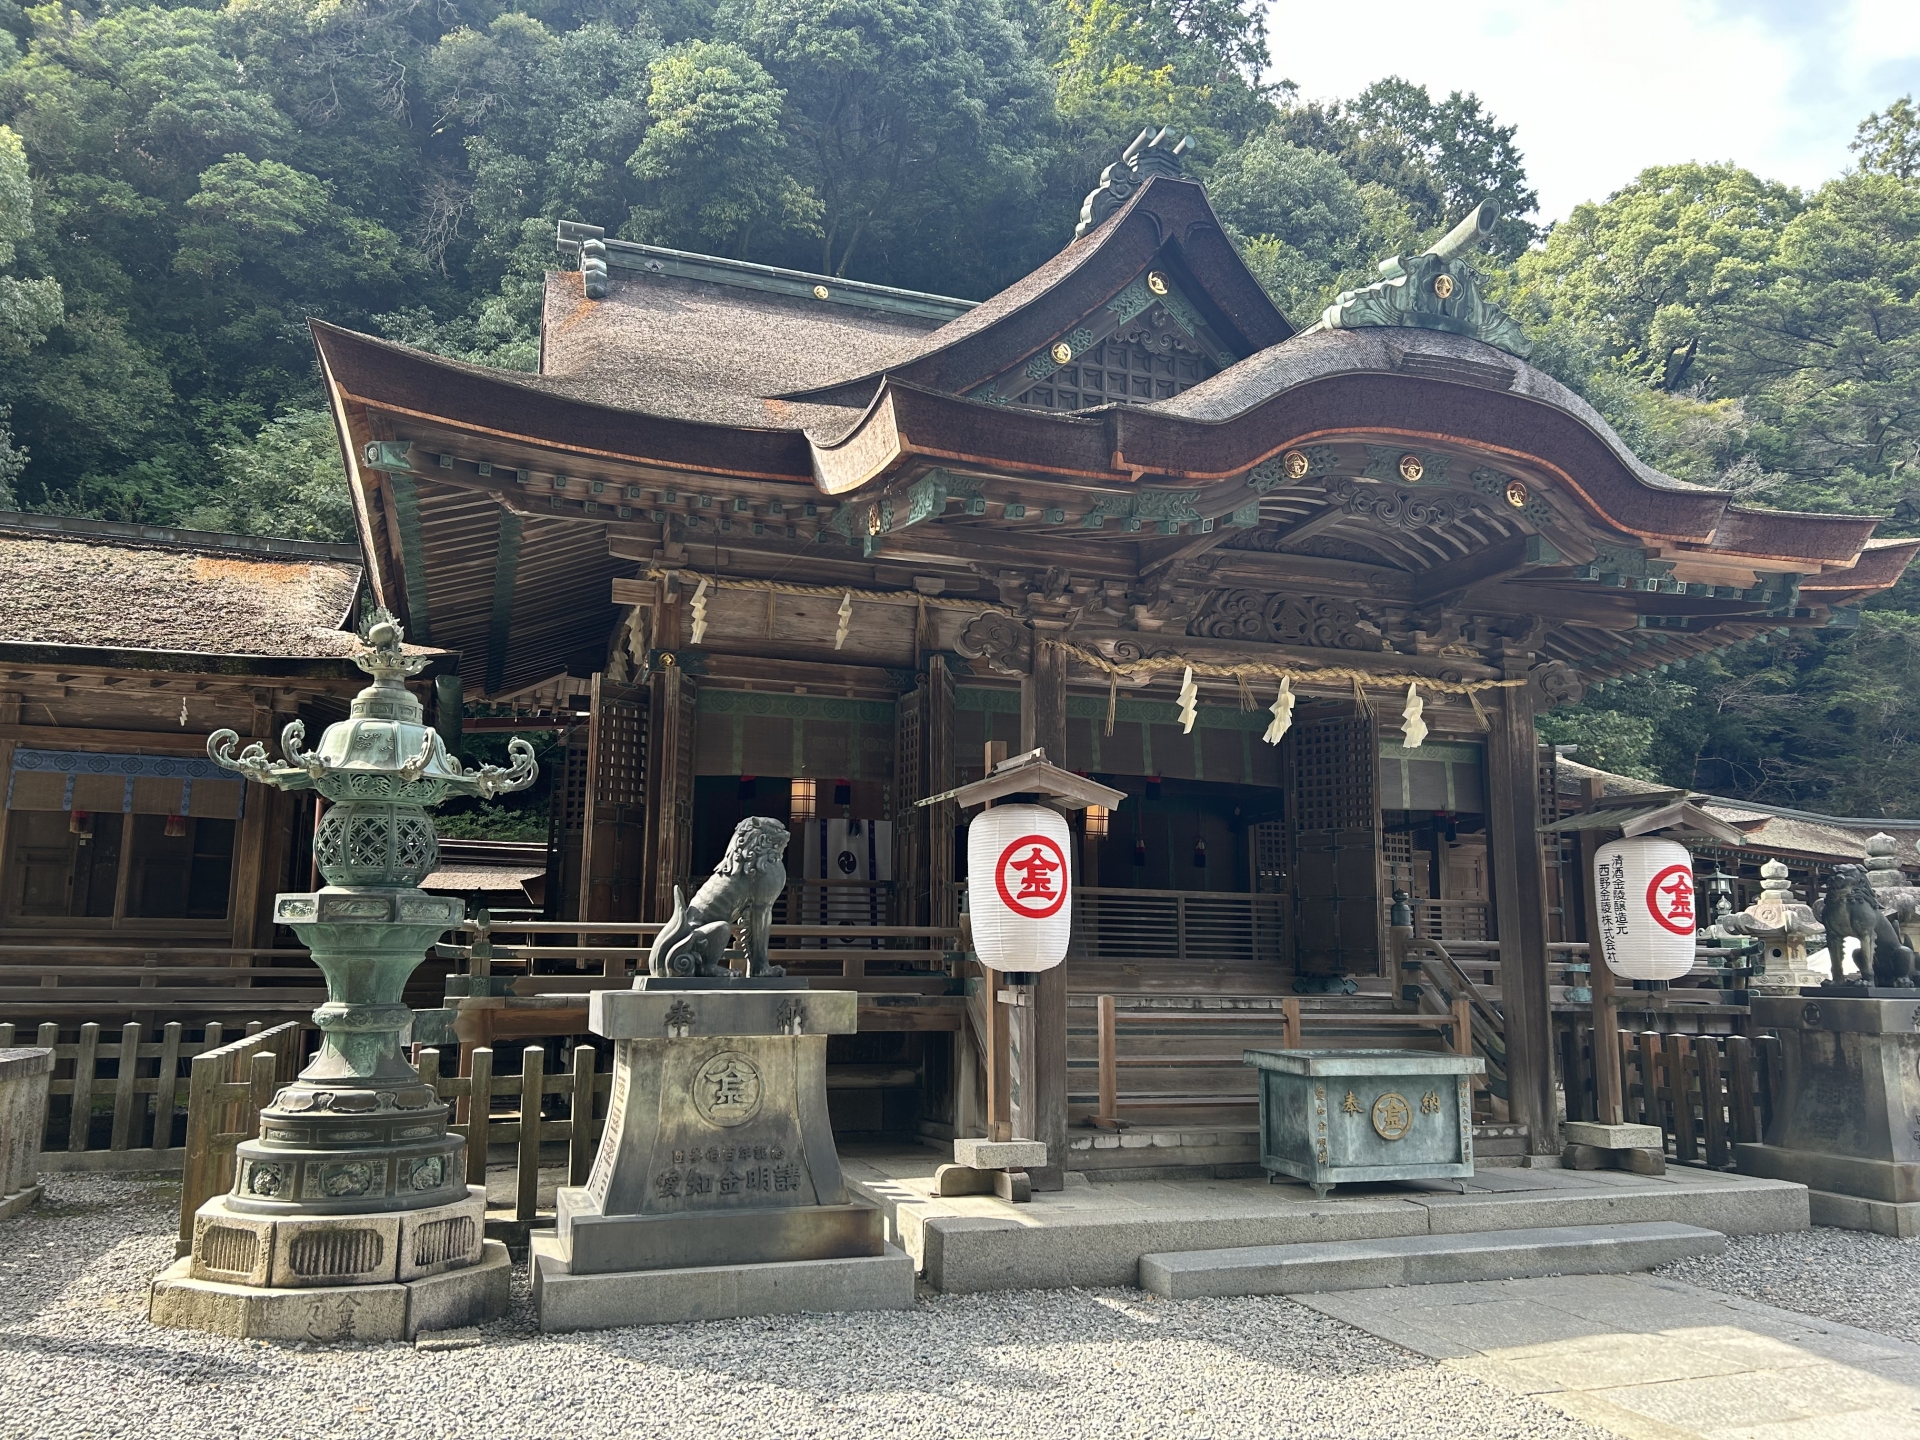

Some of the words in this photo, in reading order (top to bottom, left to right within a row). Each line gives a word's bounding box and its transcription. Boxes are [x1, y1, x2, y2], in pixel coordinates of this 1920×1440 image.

[1009, 847, 1060, 901] 金
[1659, 874, 1694, 920] 金
[1598, 863, 1619, 963] 西野金陵株式会社
[656, 1163, 801, 1198] 愛知金明講
